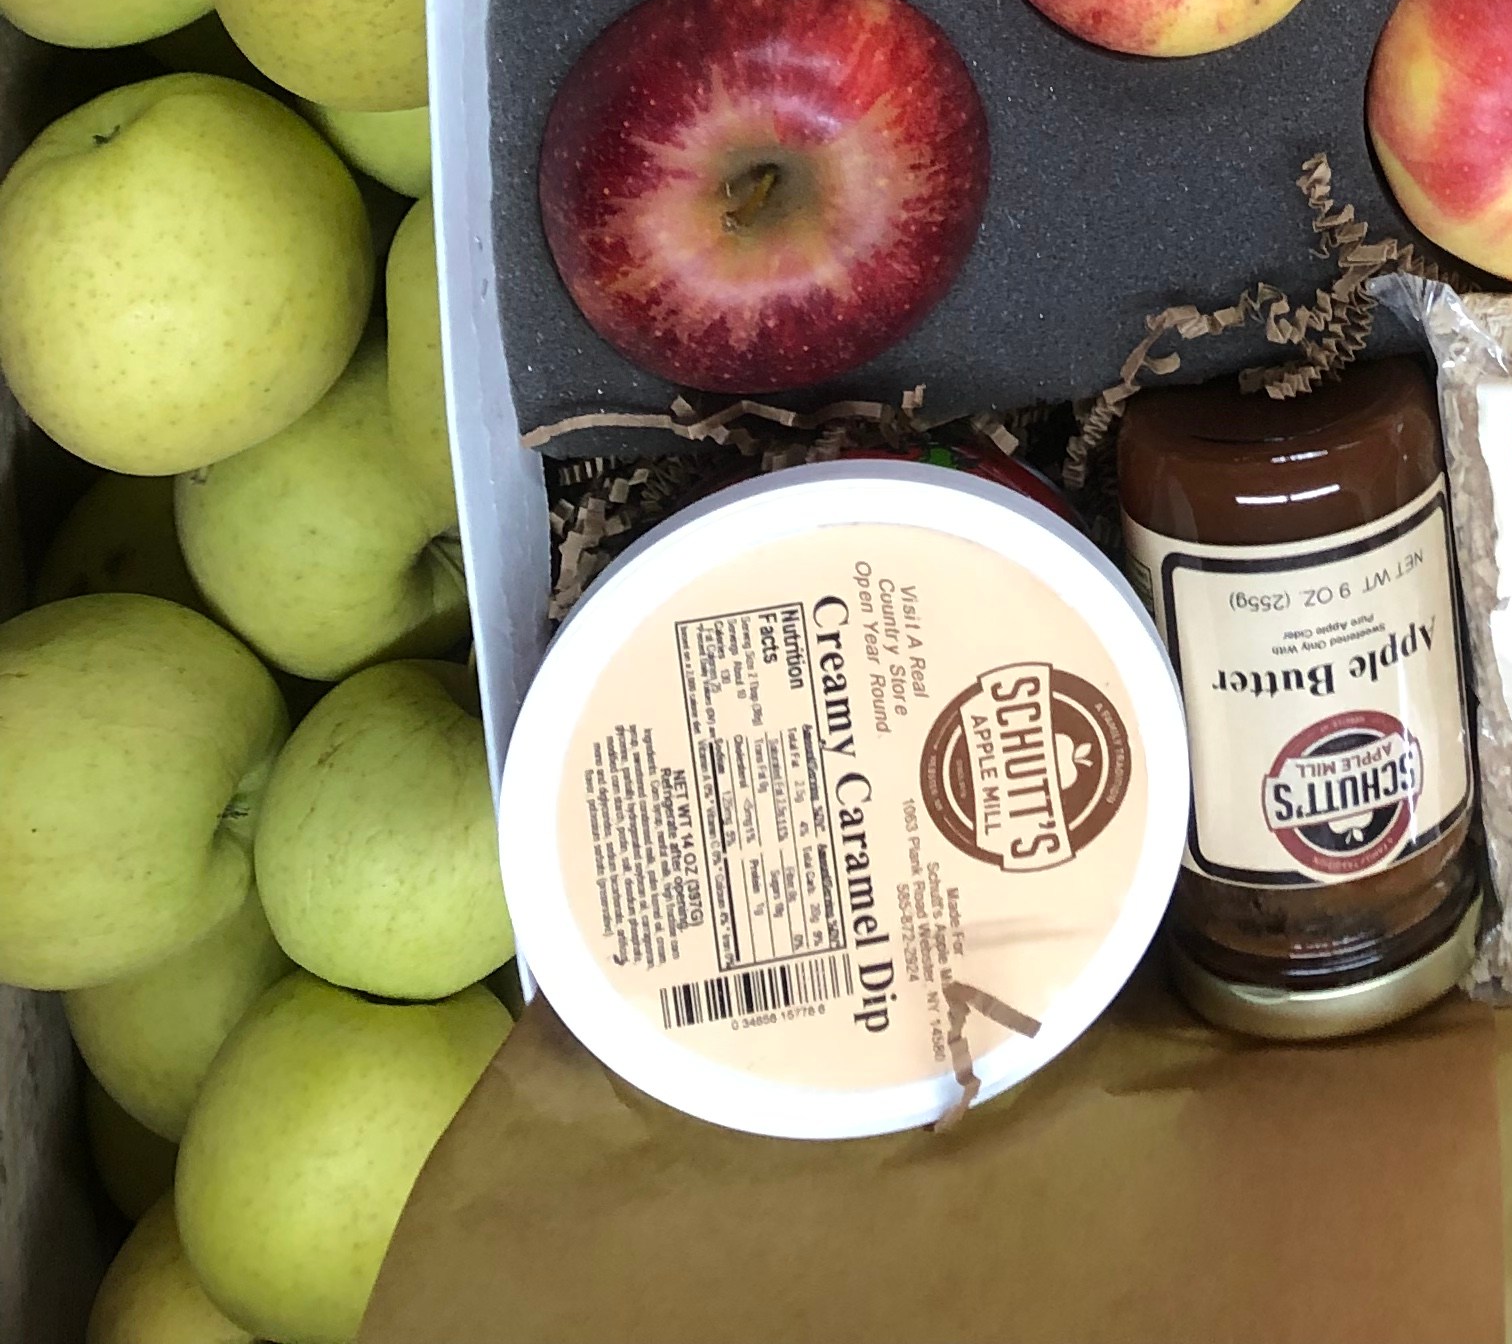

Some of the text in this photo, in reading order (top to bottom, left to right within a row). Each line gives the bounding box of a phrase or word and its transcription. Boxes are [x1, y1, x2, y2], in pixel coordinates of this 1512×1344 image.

[853, 560, 875, 613] Open
[1339, 582, 1351, 599] 9
[1362, 568, 1391, 593] WT
[1394, 548, 1424, 580] NET
[1229, 590, 1291, 611] (255g)
[1282, 613, 1374, 640] Pure Apple Cider
[759, 613, 779, 664] Facts
[781, 609, 805, 690] Nutrition
[863, 620, 882, 665] Year
[878, 578, 908, 716] Country Store
[900, 585, 929, 699] Visit A Real
[1211, 615, 1436, 699] Apple Butter
[1271, 623, 1386, 656] Sweetened Only With
[812, 595, 856, 758] Creamy
[970, 714, 1002, 836] APPLE MILL
[990, 676, 1061, 860] SCHUTT'S
[1273, 751, 1415, 821] SCHUTT'S
[1296, 741, 1392, 778] APPLE MILL
[660, 768, 678, 839] Refrigerate
[670, 842, 683, 872] after
[903, 798, 918, 832] 1063
[672, 769, 704, 927] NET WT 14 OZ (397G)
[835, 773, 889, 949] Caramel
[908, 837, 923, 876] Plank
[912, 880, 927, 918] Road
[927, 862, 948, 964] Schutt's Apple
[946, 887, 964, 955] Made For
[896, 884, 919, 982] 585-872-2924
[854, 959, 897, 1032] Dip
[926, 992, 939, 1012] NY
[930, 1019, 945, 1062] 14580
